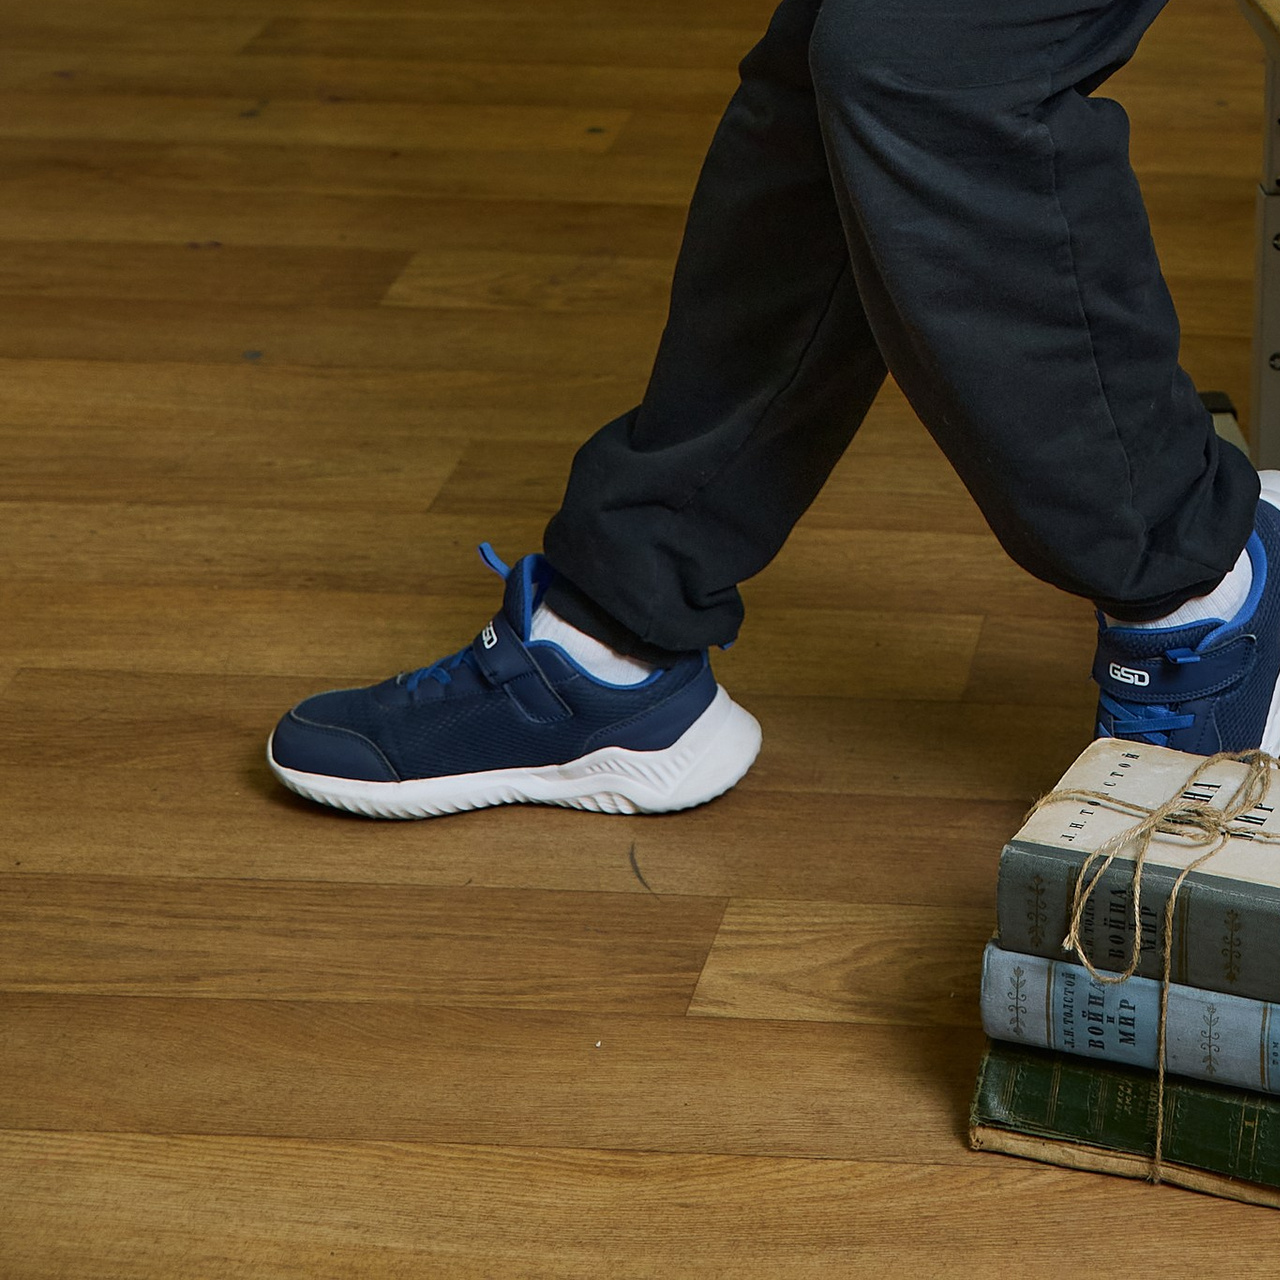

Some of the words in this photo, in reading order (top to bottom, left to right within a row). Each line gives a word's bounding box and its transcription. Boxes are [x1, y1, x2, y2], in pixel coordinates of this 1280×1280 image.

[1109, 662, 1150, 687] GSD
[1103, 889, 1127, 959] ВОЙНА
[1140, 905, 1157, 953] МИР
[1082, 981, 1105, 1050] ВОЙНА
[1106, 1015, 1115, 1024] И
[1118, 998, 1136, 1047] МИР
